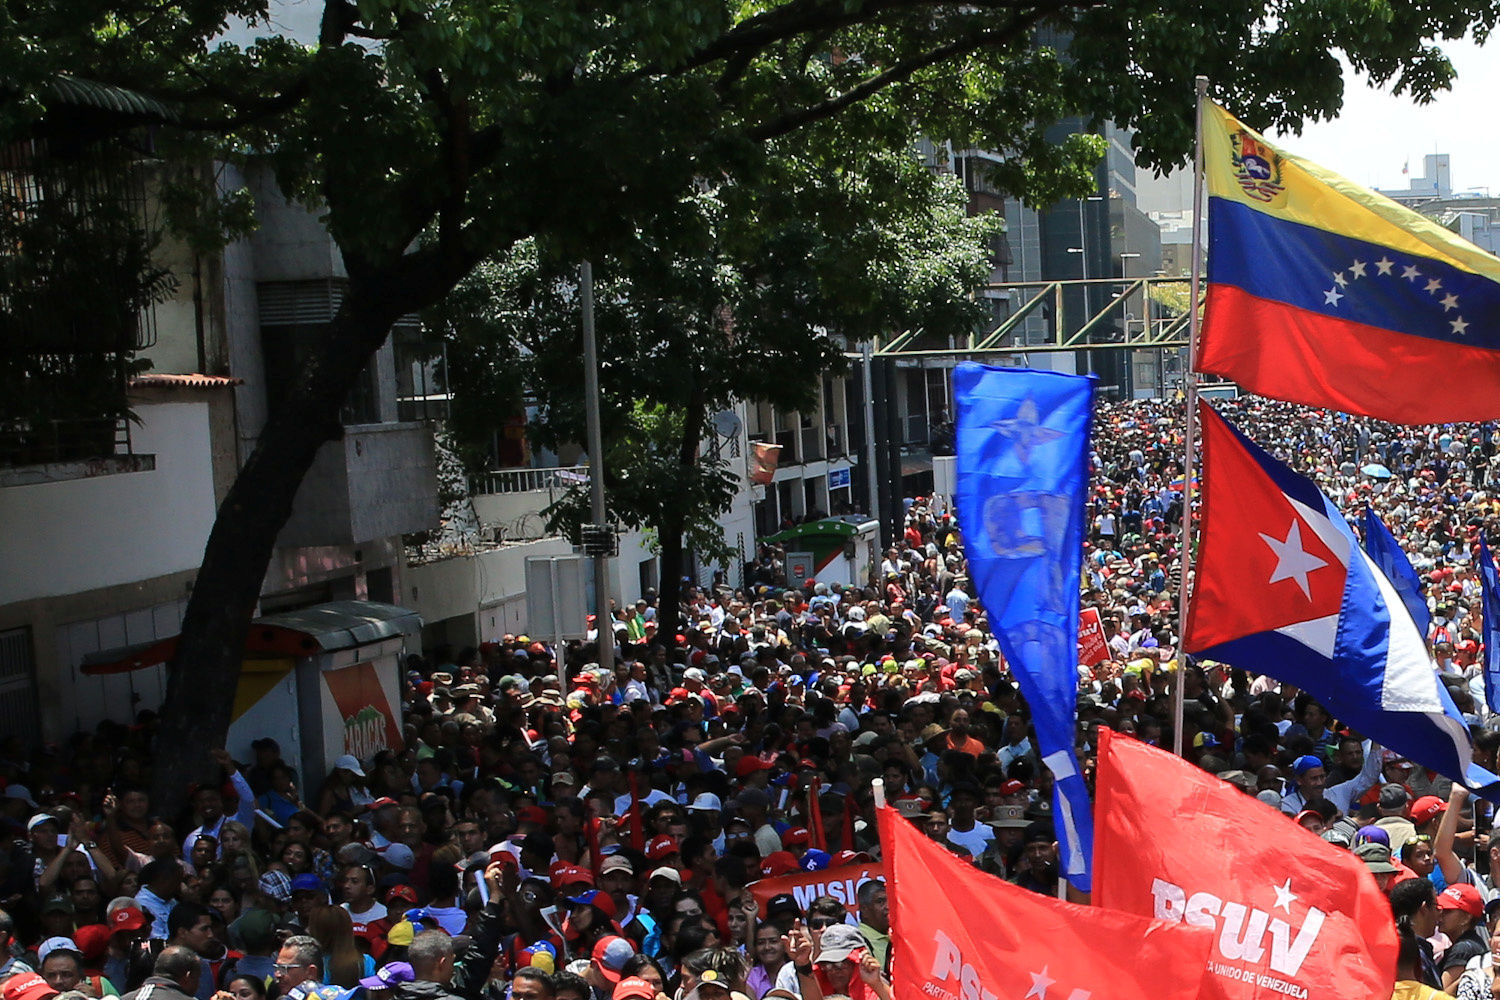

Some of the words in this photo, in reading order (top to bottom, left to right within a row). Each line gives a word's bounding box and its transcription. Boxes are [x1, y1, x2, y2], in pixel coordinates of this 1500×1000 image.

[1215, 965, 1241, 980] UNIDO
[1242, 971, 1254, 984] DE
[1256, 974, 1309, 1000] VENEZUELA
